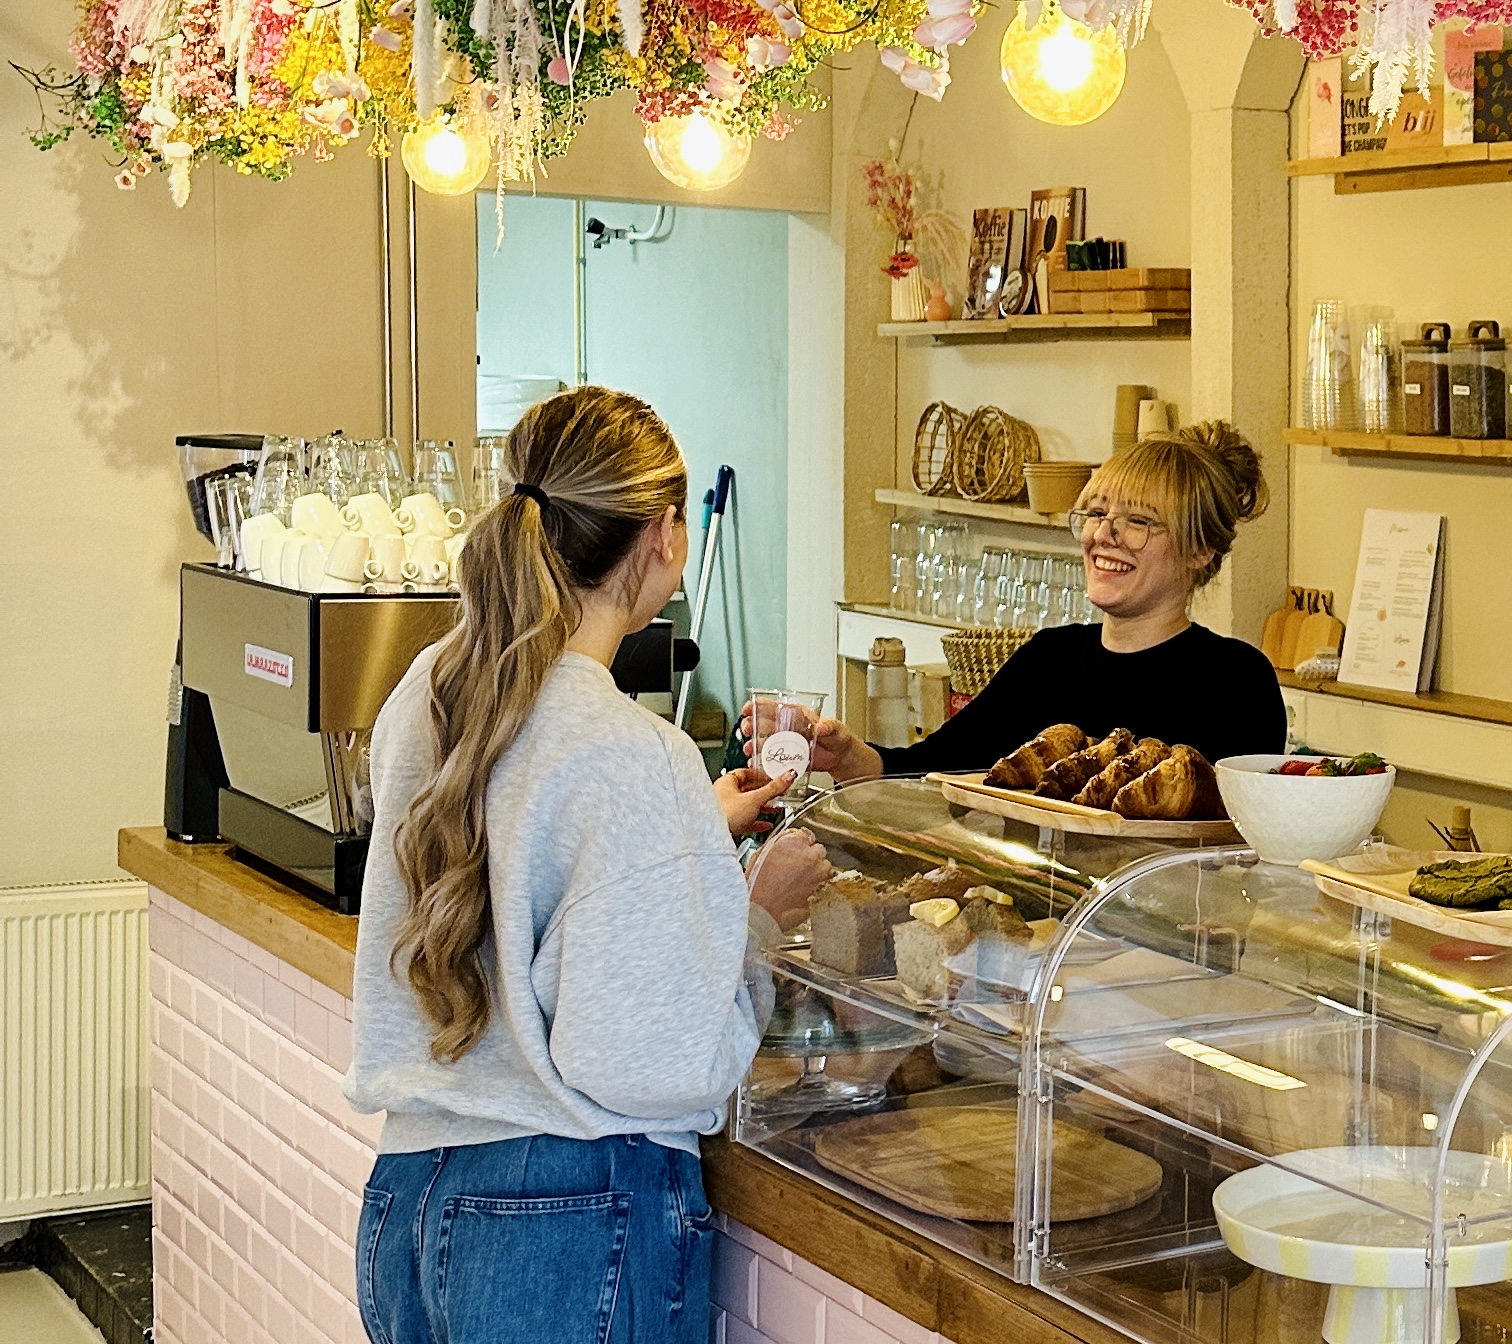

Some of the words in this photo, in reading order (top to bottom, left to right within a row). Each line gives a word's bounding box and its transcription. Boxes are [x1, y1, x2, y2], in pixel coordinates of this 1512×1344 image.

[1403, 109, 1437, 135] blij
[1032, 197, 1071, 220] KOFFIE
[974, 213, 1006, 238] Koffie
